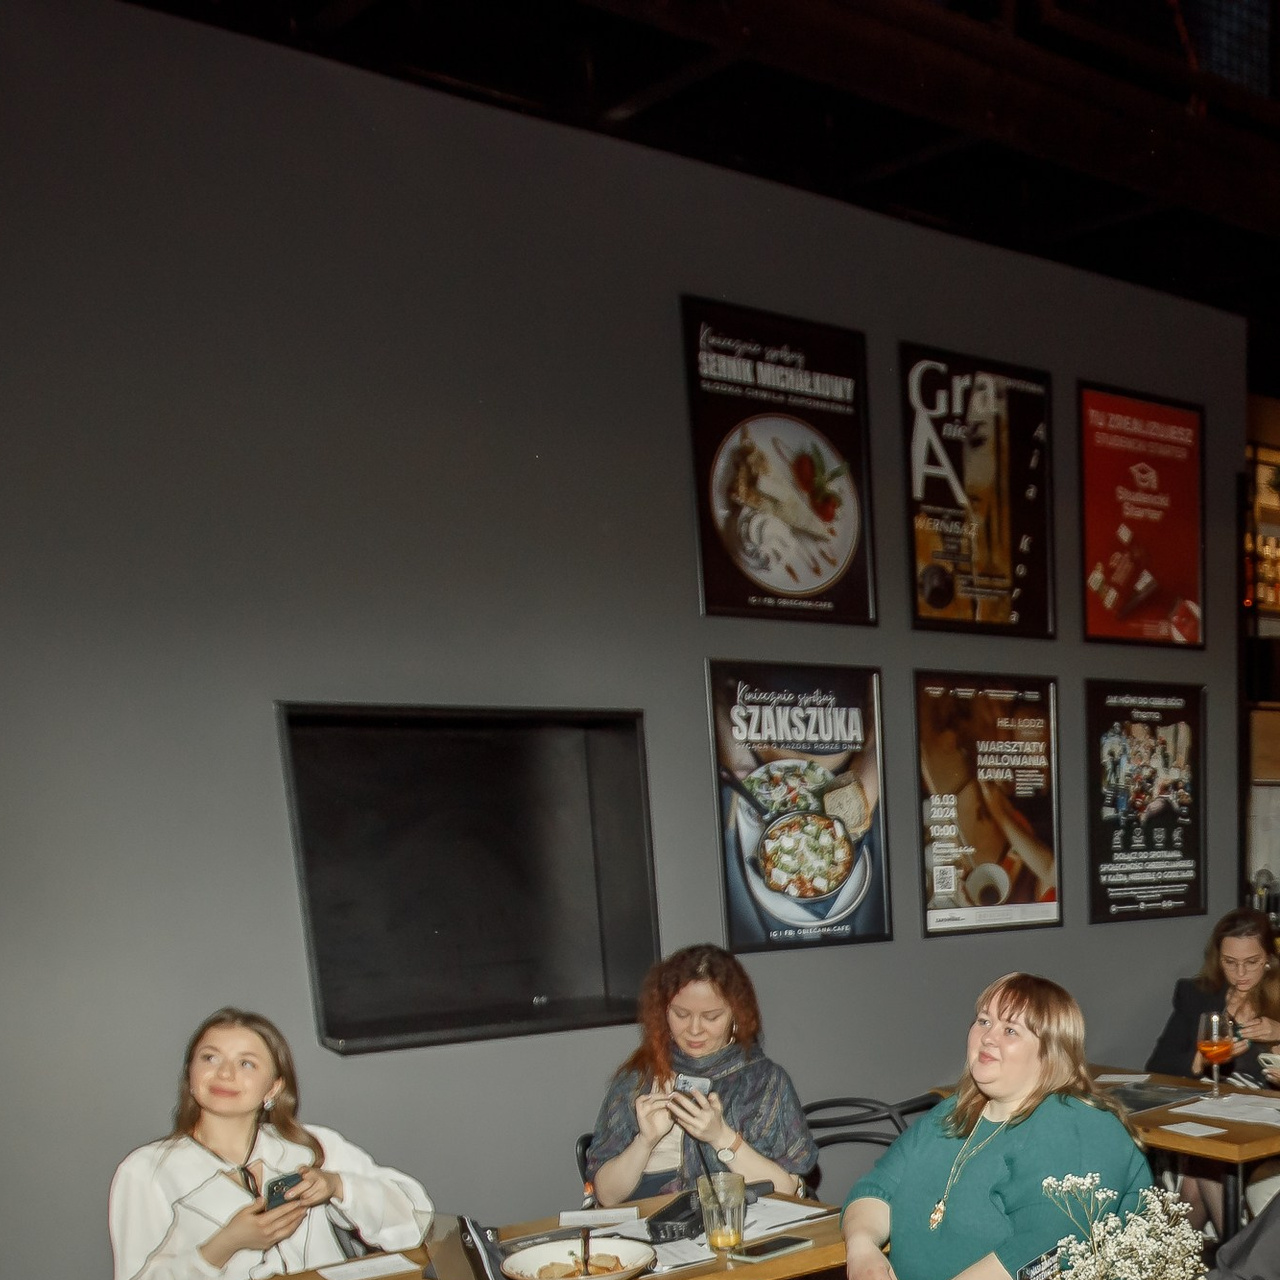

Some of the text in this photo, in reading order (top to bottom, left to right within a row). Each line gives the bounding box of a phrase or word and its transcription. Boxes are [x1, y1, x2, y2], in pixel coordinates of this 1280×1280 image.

[909, 359, 998, 419] Gra
[730, 705, 864, 742] SZAKSZUKA
[976, 740, 1047, 754] WARSZTATY
[976, 754, 1049, 767] MALOWANIA
[930, 794, 956, 805] 16.03
[930, 807, 956, 819] 2024
[930, 824, 957, 836] 10:00
